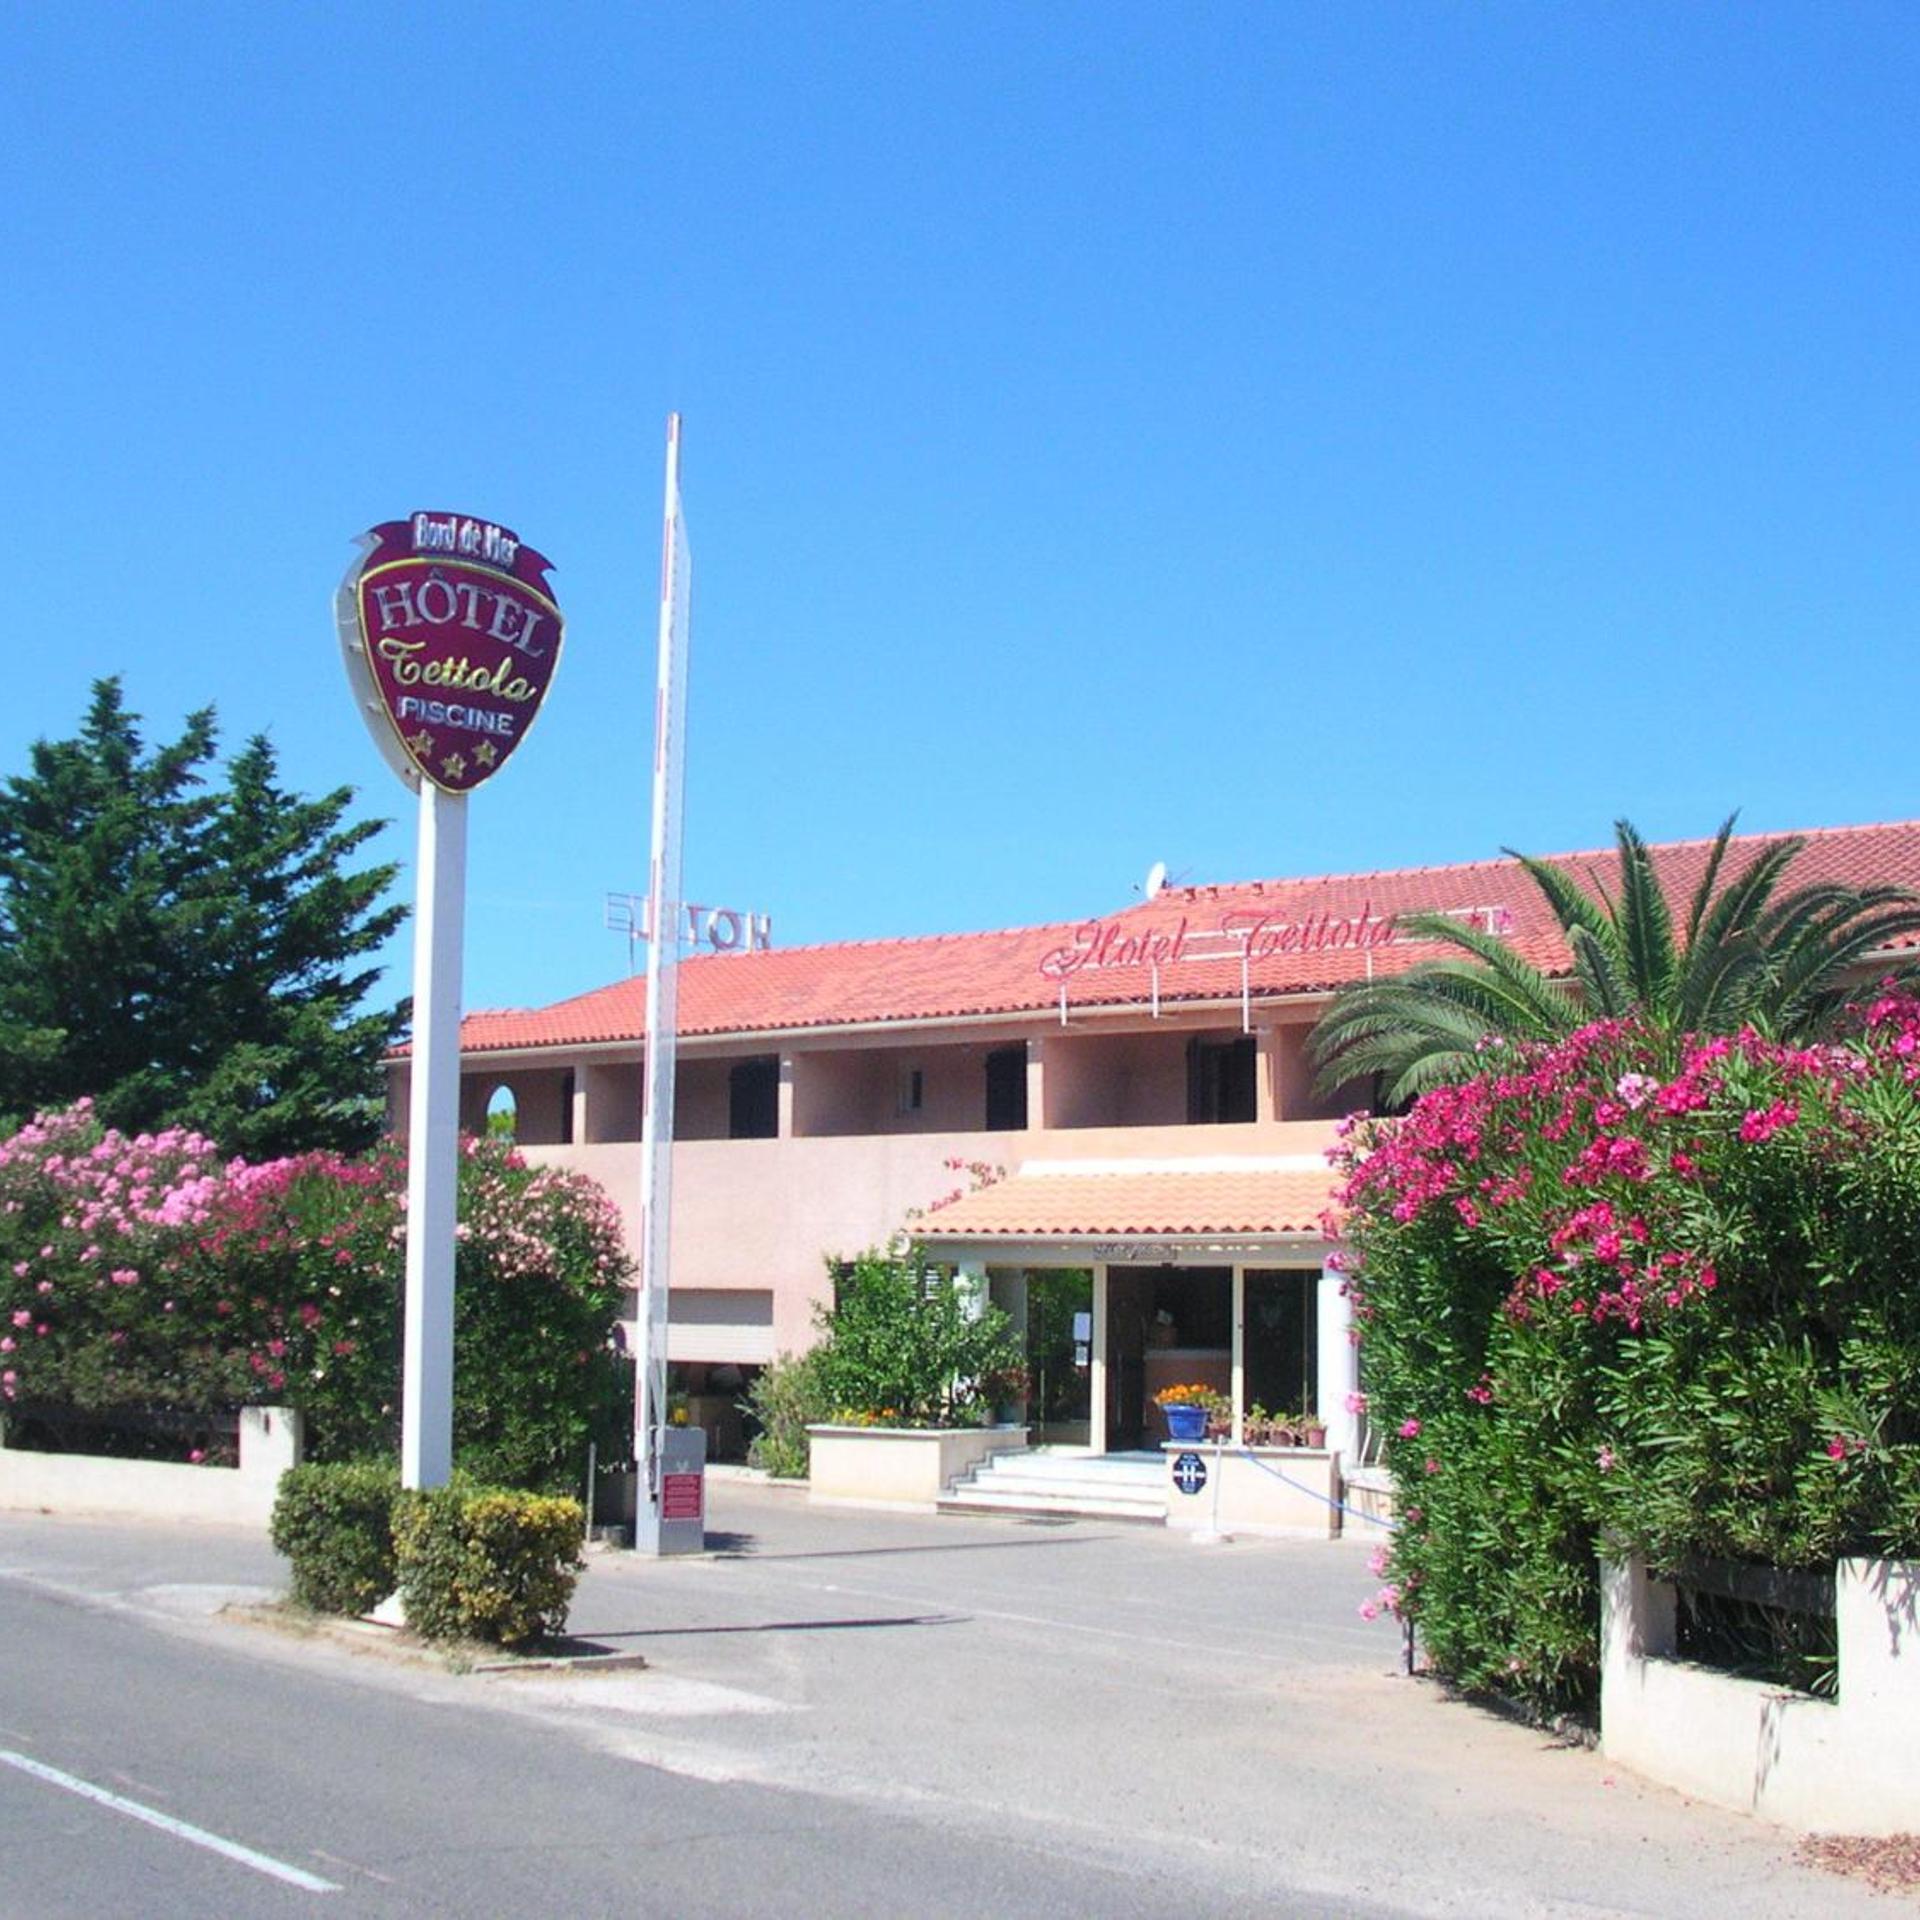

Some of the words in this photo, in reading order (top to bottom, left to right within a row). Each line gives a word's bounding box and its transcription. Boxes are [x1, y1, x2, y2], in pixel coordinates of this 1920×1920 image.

[414, 513, 457, 551] Bord
[459, 519, 482, 555] de
[482, 524, 519, 568] Mer
[373, 567, 545, 658] HÔTEL
[377, 637, 537, 701] Tettola
[397, 695, 515, 735] PISCINE
[1039, 915, 1187, 981] Hotel
